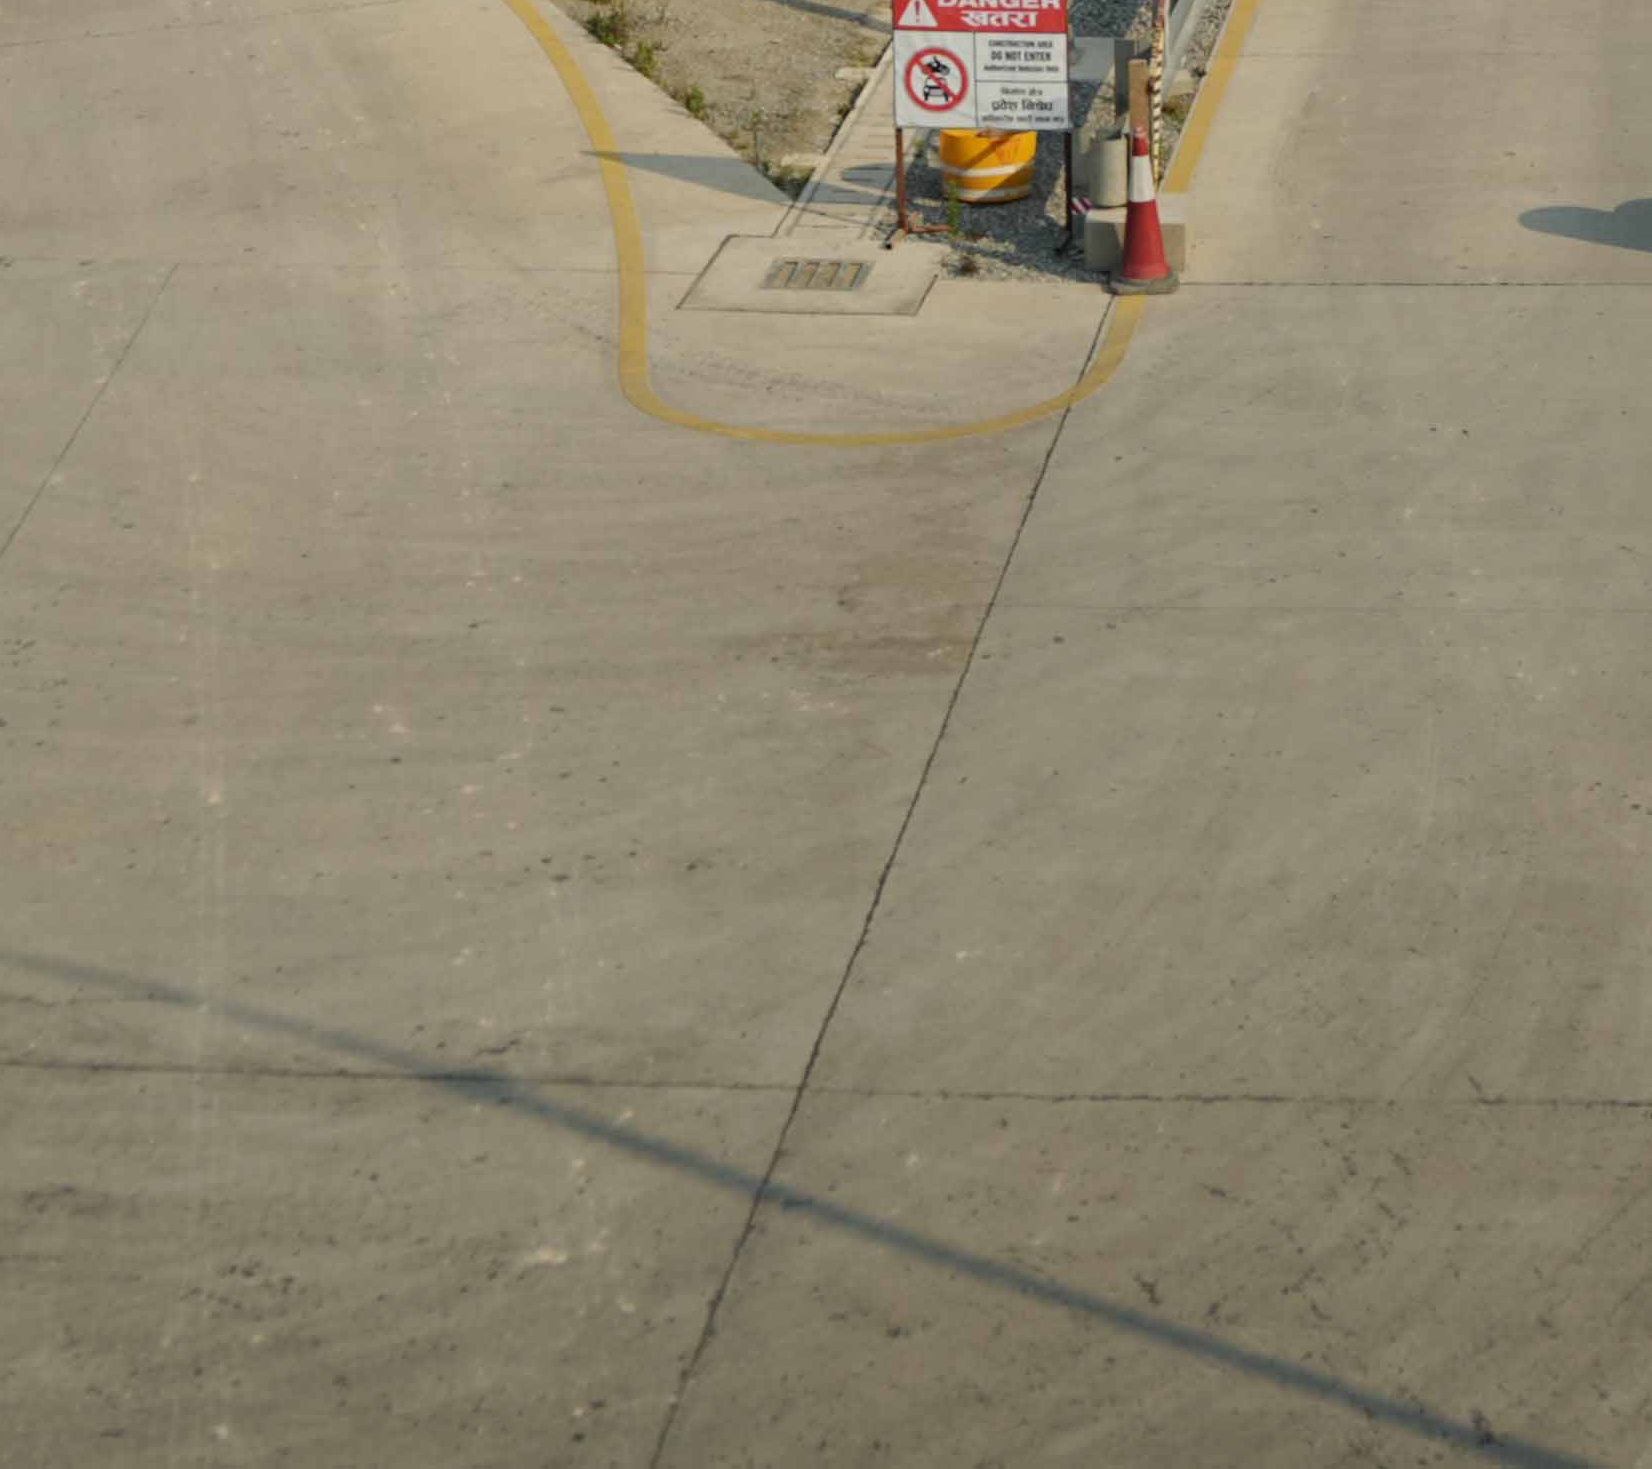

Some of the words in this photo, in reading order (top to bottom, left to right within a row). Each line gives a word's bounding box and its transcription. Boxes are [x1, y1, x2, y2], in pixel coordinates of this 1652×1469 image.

[960, 10, 1038, 28] खतरा
[991, 51, 1003, 61] DO
[1005, 51, 1021, 61] NOT
[1023, 51, 1052, 62] ENTER
